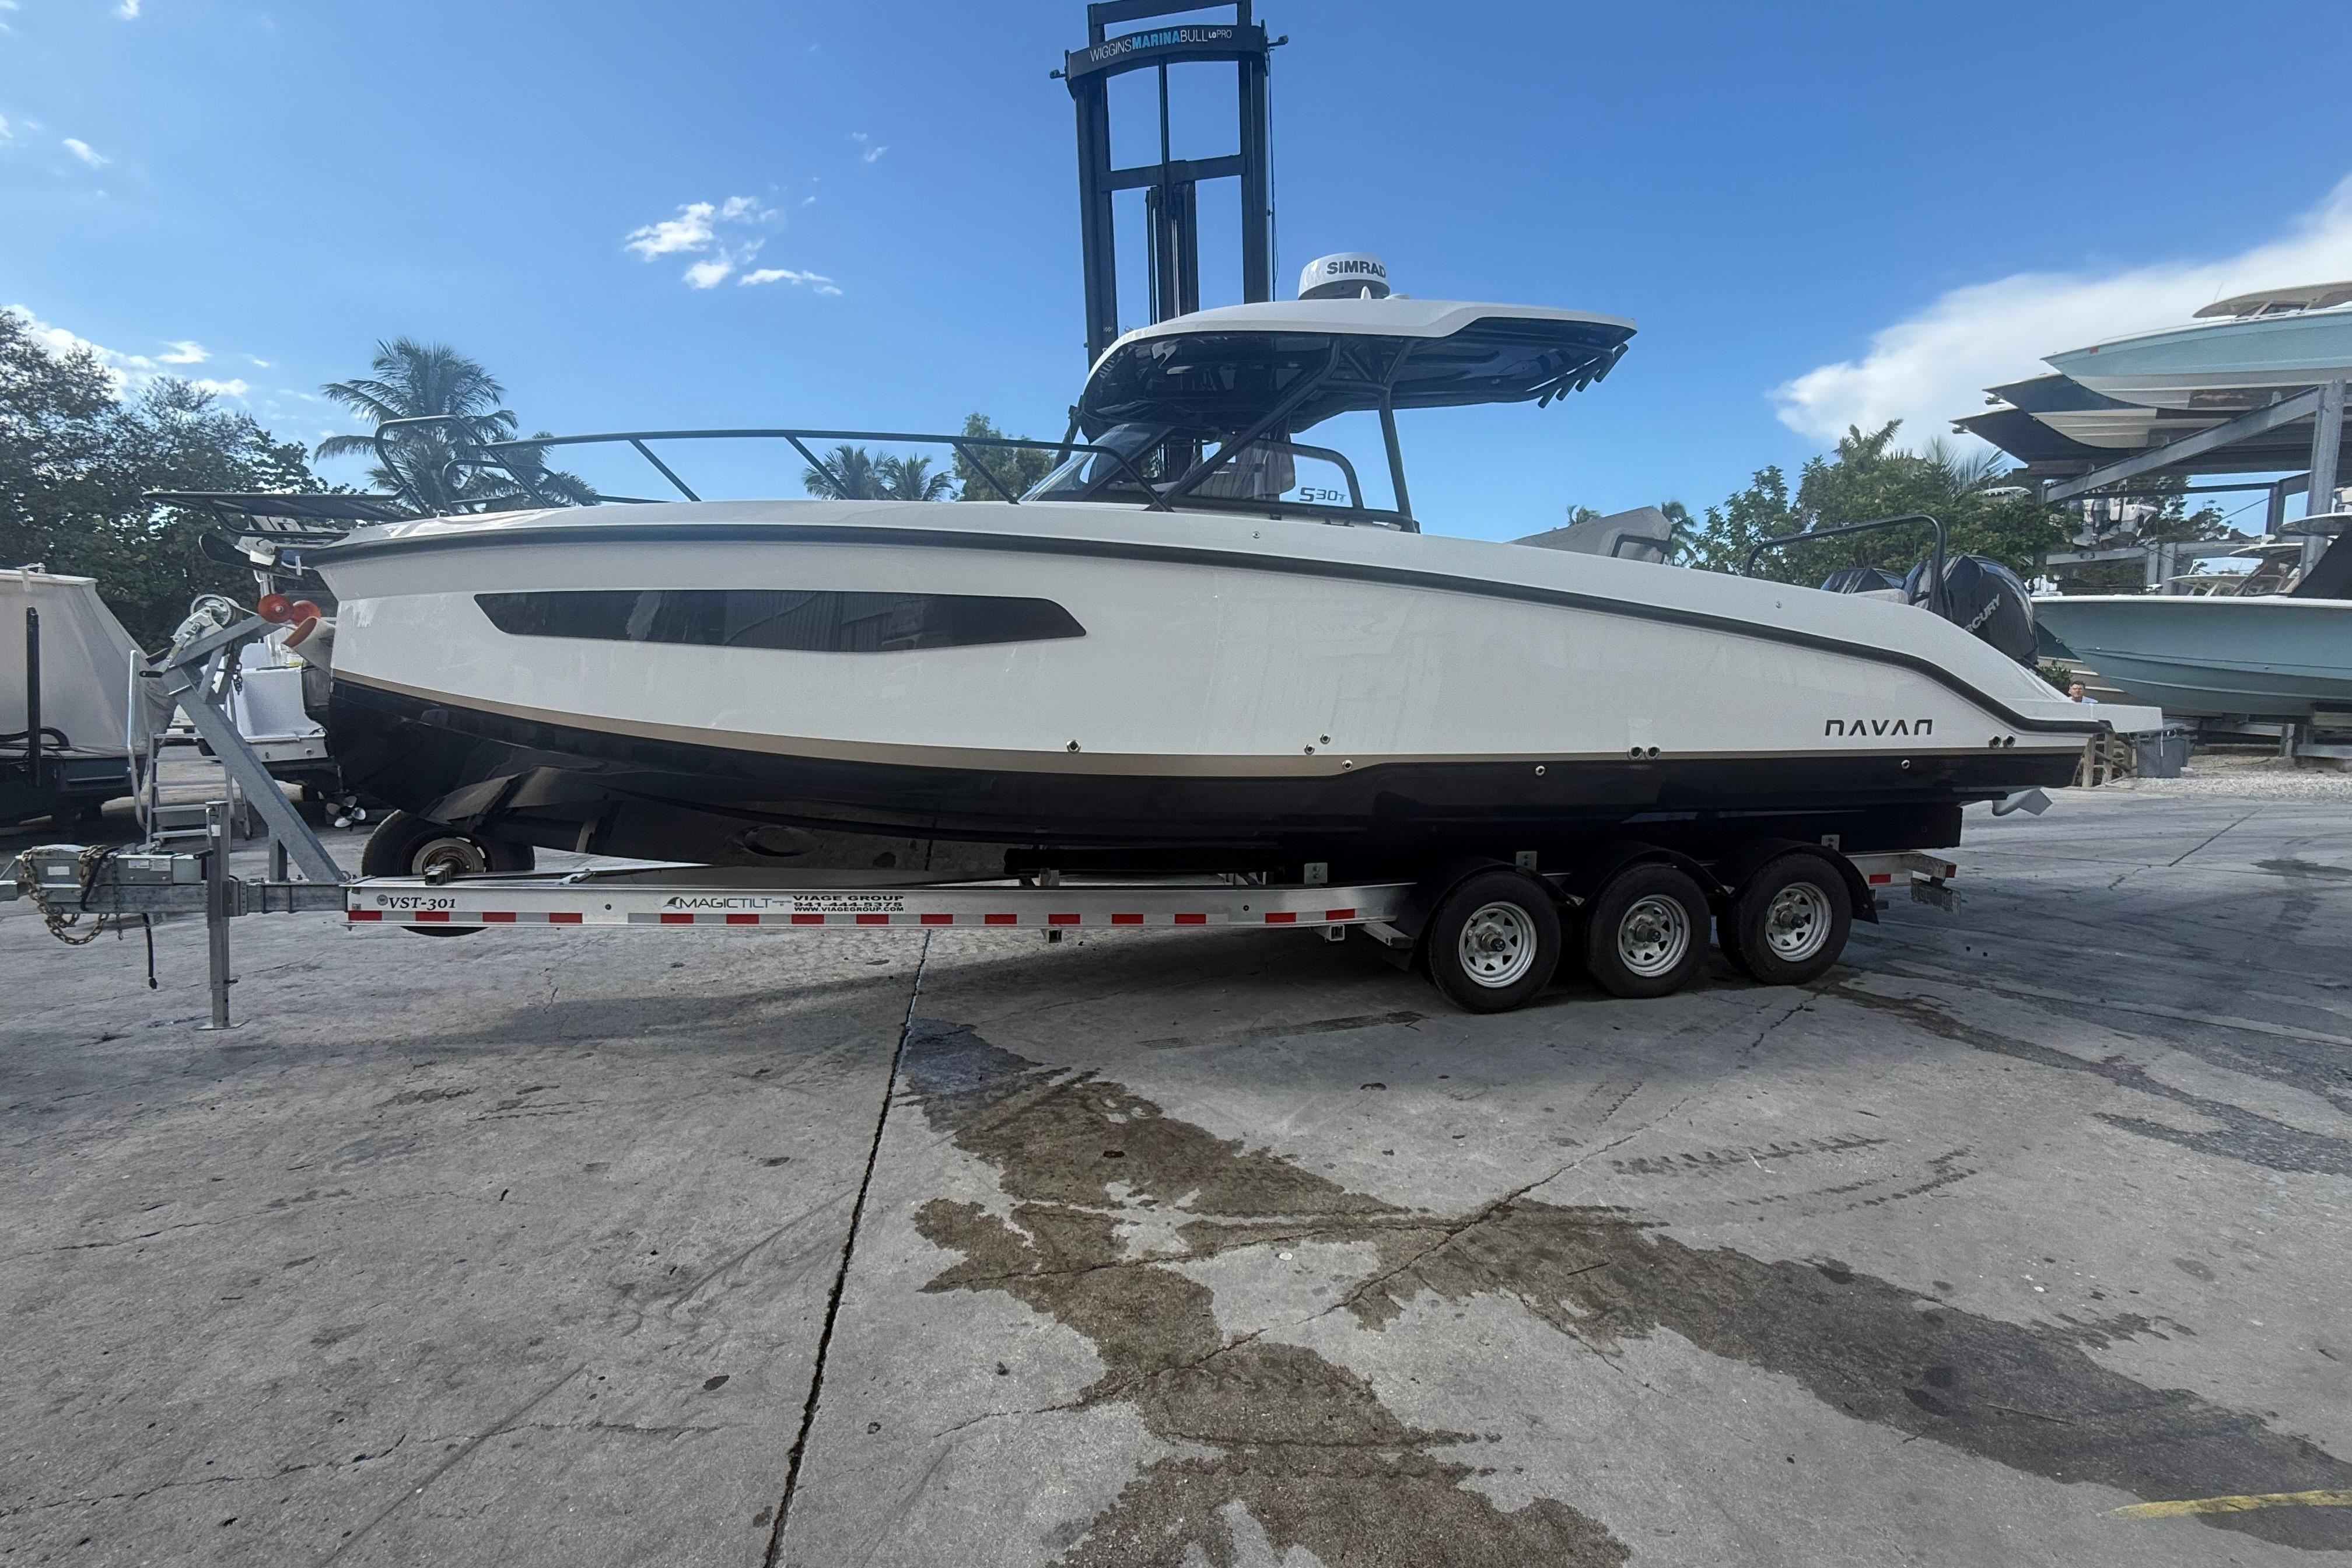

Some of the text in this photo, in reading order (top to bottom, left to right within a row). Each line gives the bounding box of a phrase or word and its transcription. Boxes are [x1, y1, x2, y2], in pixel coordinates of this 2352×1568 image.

[1326, 260, 1387, 279] SIMRAD
[1964, 593, 2000, 632] RCURY
[388, 897, 456, 911] VST-301
[679, 898, 772, 908] MAGICTILT
